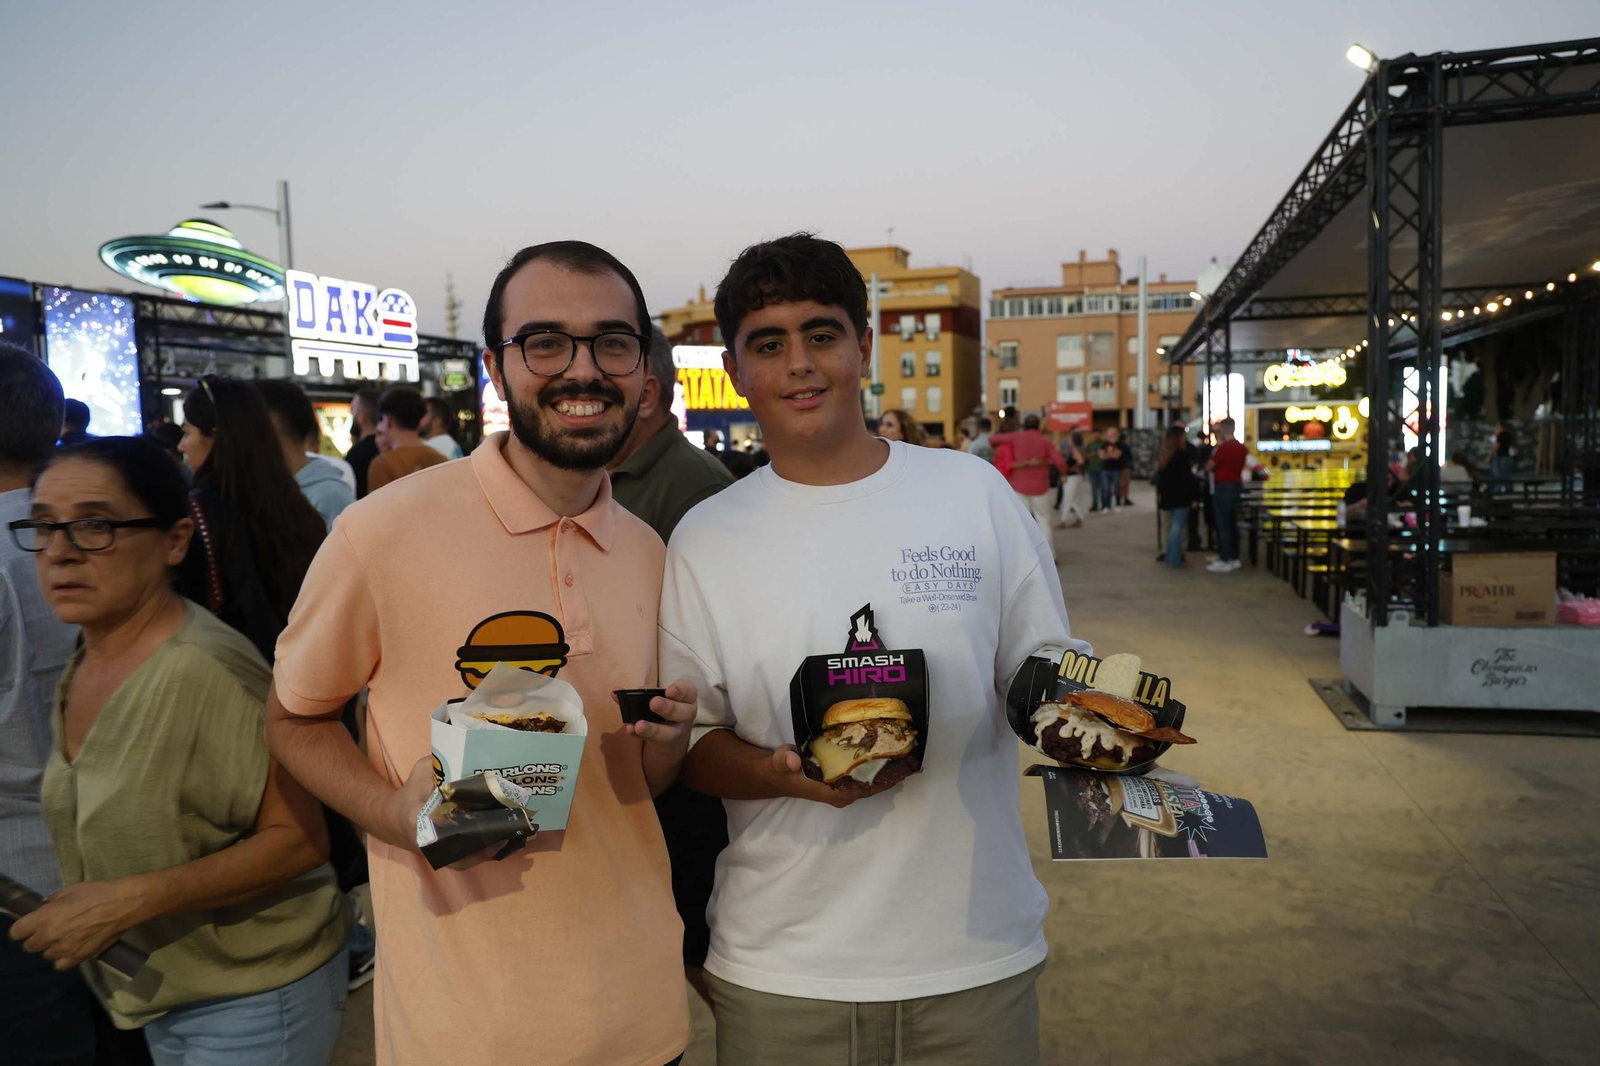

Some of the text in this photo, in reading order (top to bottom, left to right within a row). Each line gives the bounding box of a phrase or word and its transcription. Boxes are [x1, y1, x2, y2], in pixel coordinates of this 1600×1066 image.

[901, 545, 976, 563] Feels Good
[890, 568, 907, 582] to
[909, 563, 929, 580] do
[905, 581, 974, 592] EASY DAYS
[899, 596, 916, 604] Take
[921, 593, 966, 602] Well-Deserved
[827, 654, 905, 670] SMASH
[828, 666, 906, 686] HIRO
